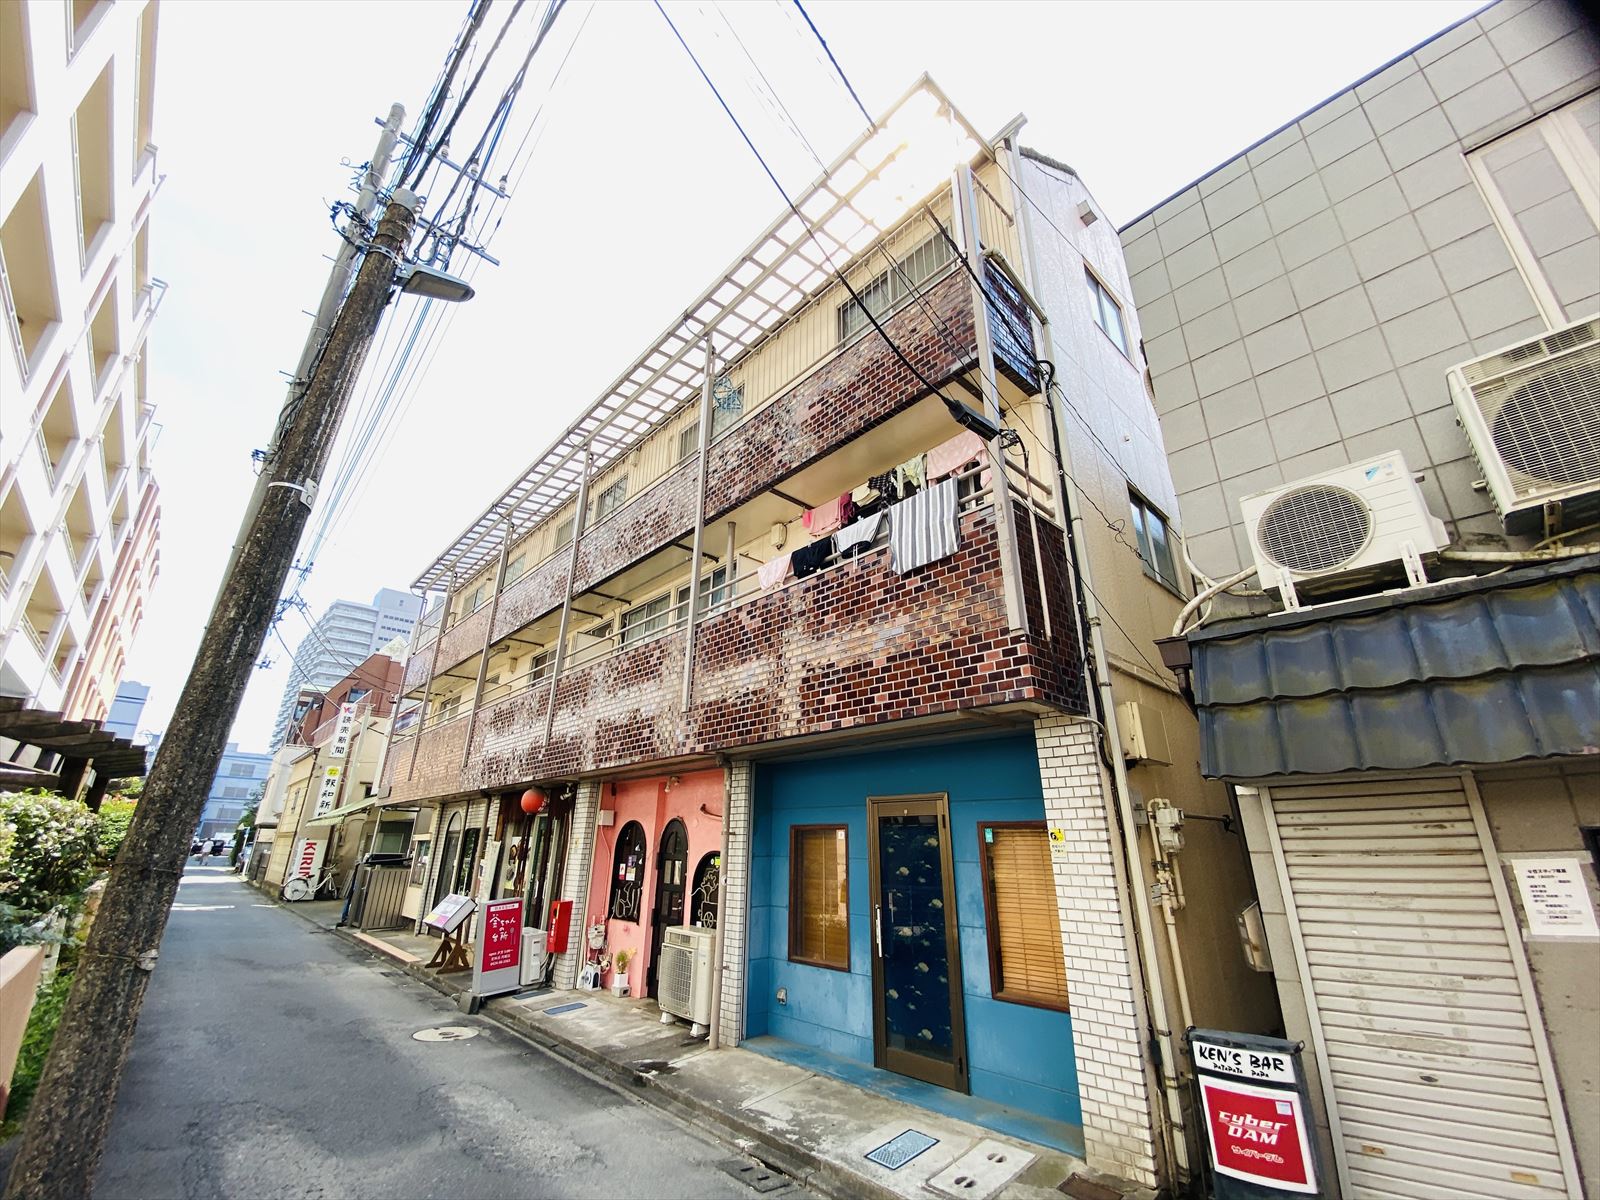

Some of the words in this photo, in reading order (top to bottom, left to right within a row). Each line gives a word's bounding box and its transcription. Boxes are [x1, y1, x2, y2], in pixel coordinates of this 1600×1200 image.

[334, 716, 352, 754] 読売新聞
[1199, 1045, 1242, 1066] KEN'S
[1249, 1054, 1285, 1072] BAR
[1228, 1125, 1279, 1146] DAM
